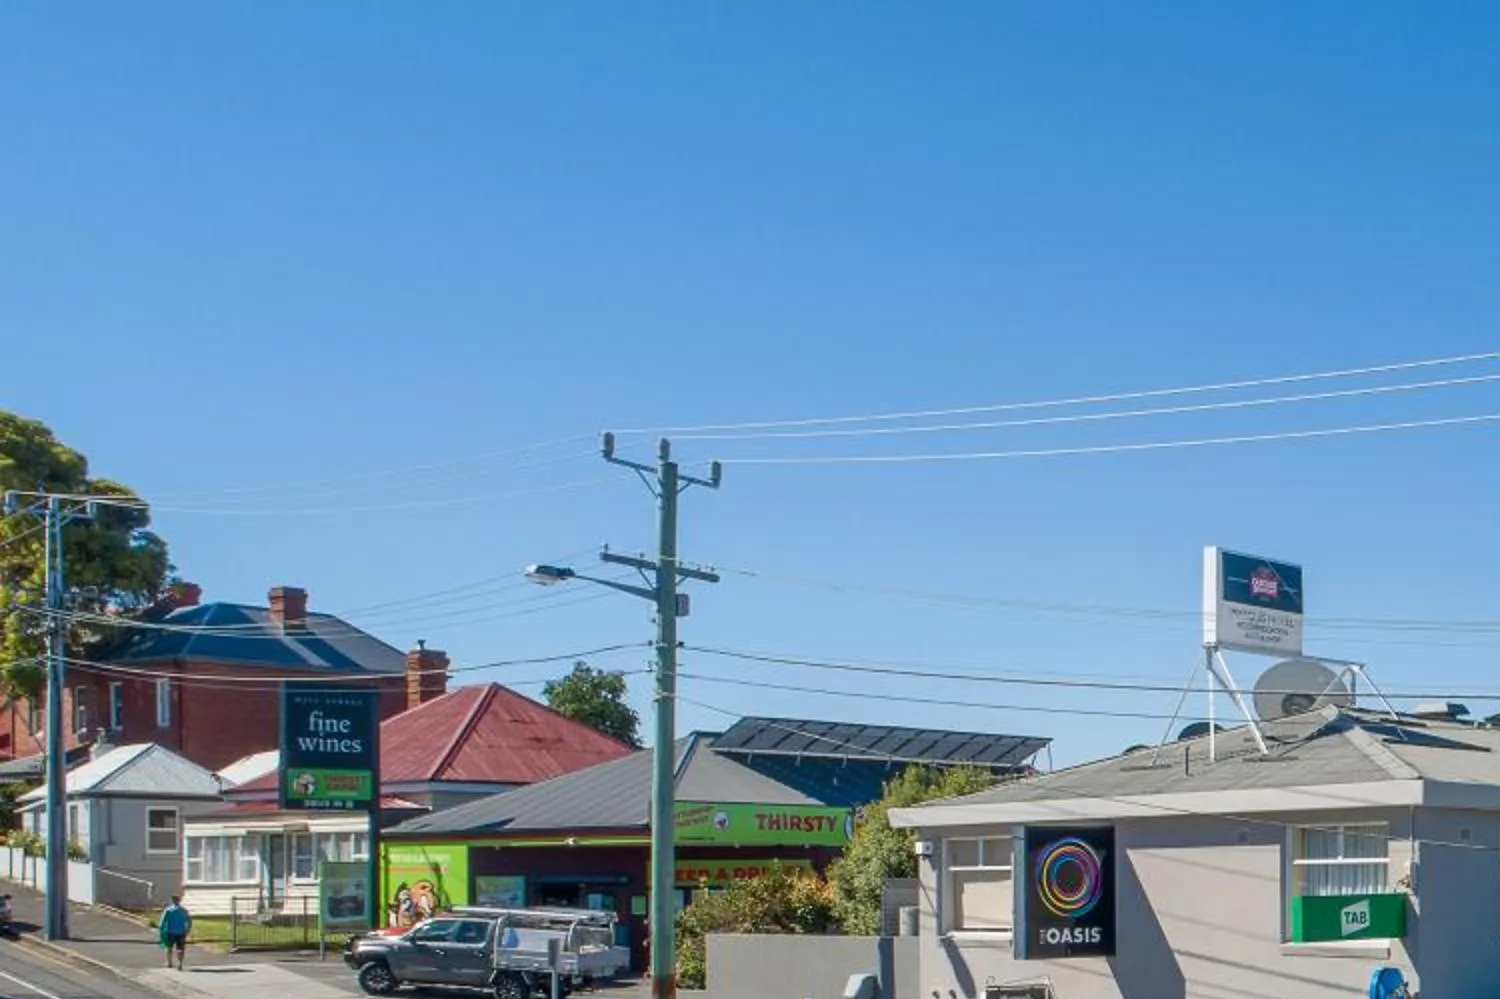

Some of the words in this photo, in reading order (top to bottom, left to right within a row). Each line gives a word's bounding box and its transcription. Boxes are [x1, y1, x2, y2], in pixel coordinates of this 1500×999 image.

[309, 710, 351, 733] fine
[297, 736, 363, 753] wines
[755, 813, 837, 833] THIRSTY
[1344, 911, 1368, 925] TAB
[1046, 927, 1103, 945] OASIS
